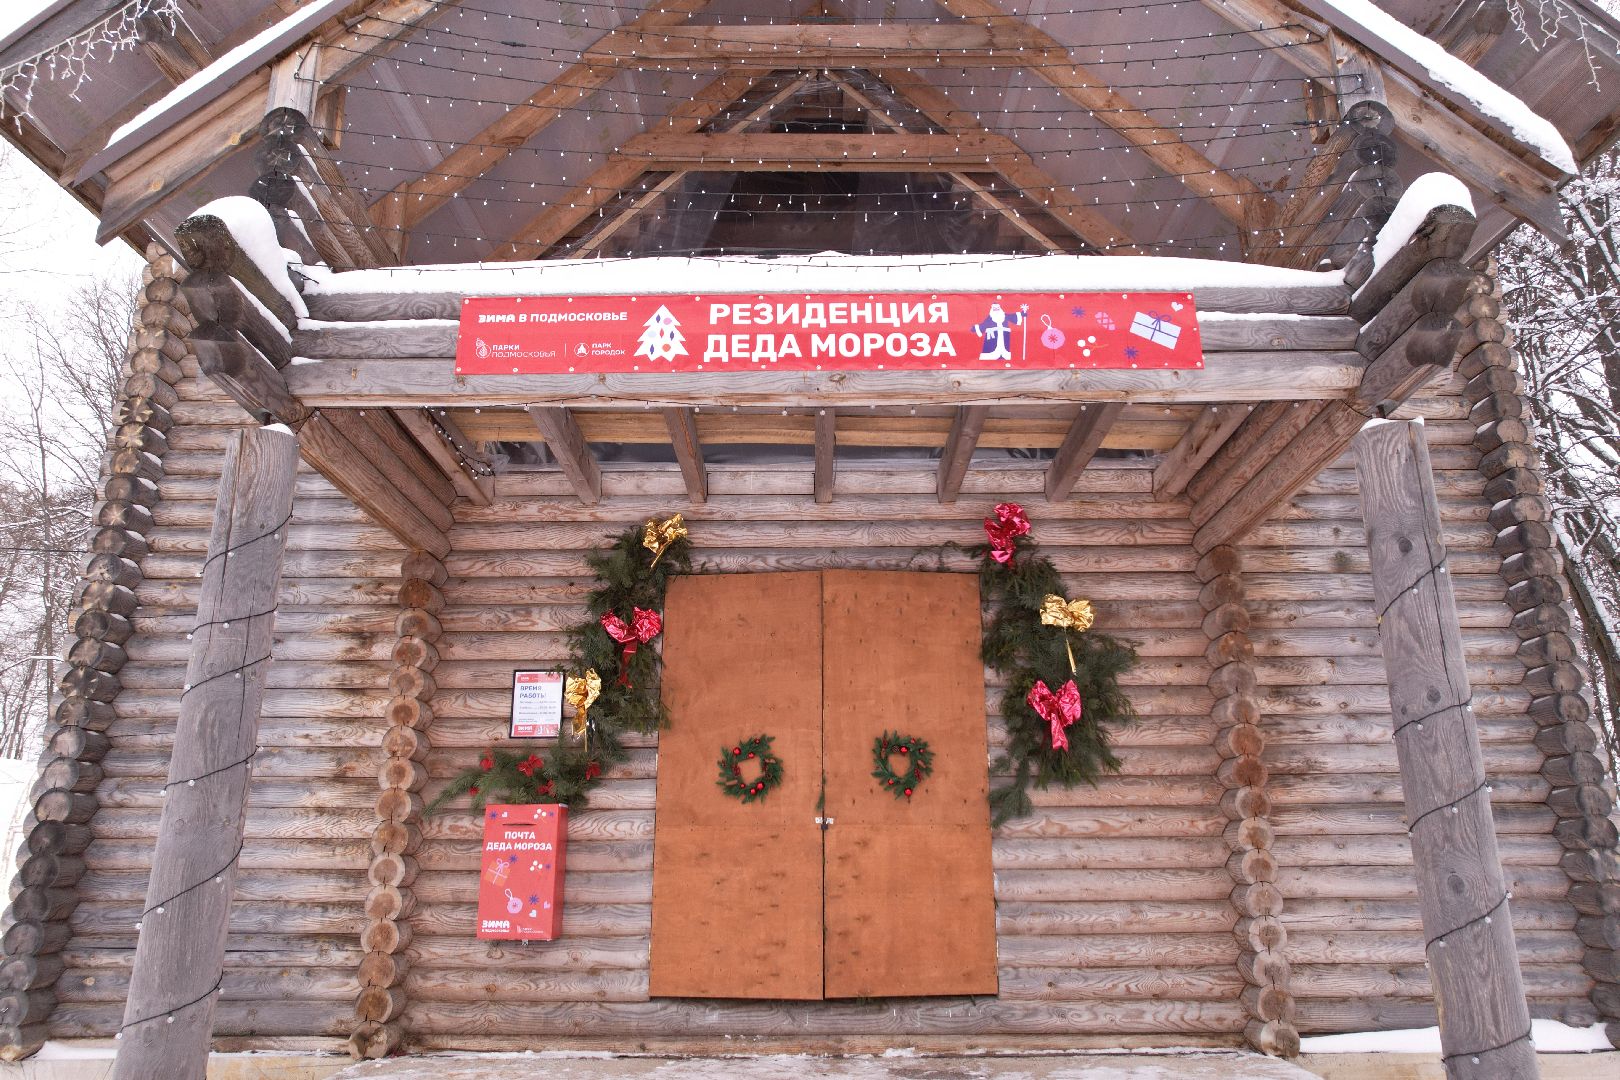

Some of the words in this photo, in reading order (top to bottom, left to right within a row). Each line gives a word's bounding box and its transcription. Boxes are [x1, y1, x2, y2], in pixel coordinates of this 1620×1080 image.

[478, 314, 515, 323] ЗИМА
[519, 313, 527, 323] В
[530, 312, 628, 323] ПОДМОСКОВЬЕ
[709, 302, 949, 328] РЕЗИДЕНЦИЯ
[703, 333, 802, 362] ДЕДА
[811, 332, 957, 358] МОРОЗА
[491, 350, 556, 358] ПОДМОСКОВЬЯ
[504, 831, 536, 840] ПОЧТА
[486, 842, 512, 851] ДЕДА
[514, 842, 553, 851] МОРОЗА
[481, 920, 510, 928] ЗИМА
